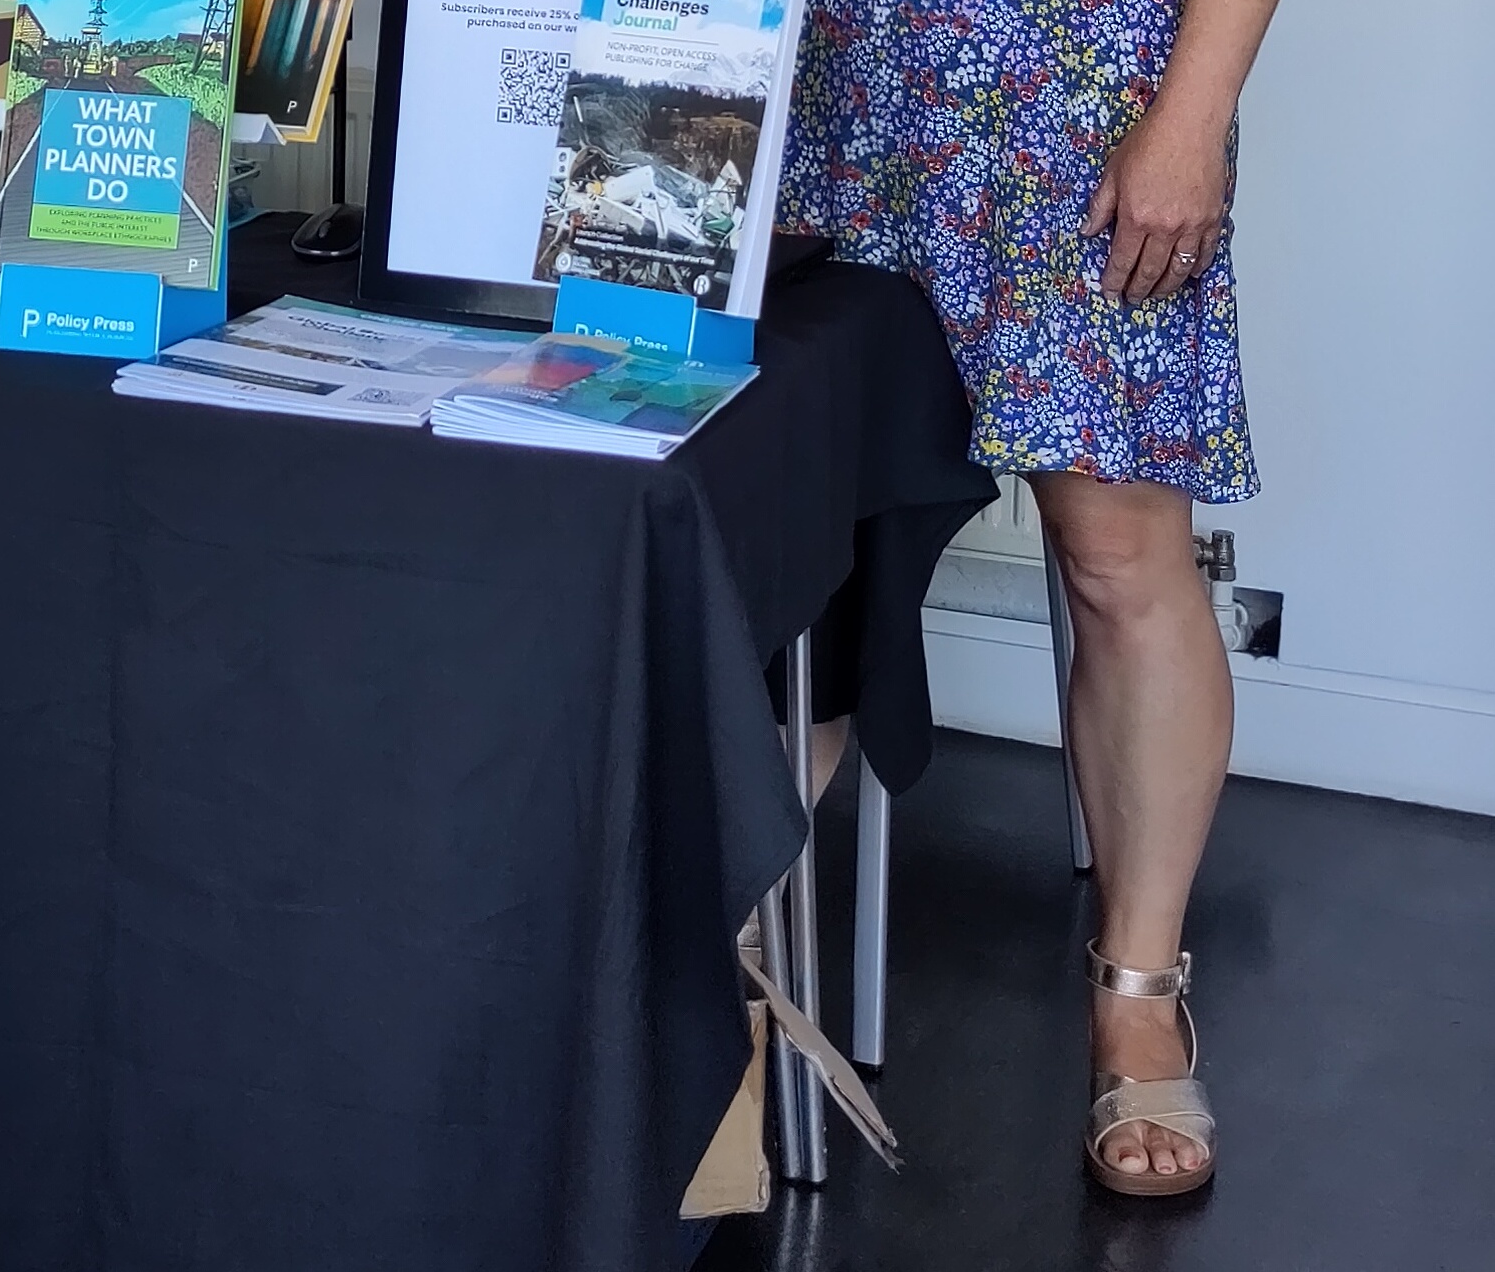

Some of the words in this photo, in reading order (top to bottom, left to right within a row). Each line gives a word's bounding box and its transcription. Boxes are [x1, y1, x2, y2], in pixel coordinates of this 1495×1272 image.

[440, 1, 505, 16] Subscribers
[506, 6, 548, 19] receive
[549, 8, 571, 20] 25%
[613, 11, 679, 32] Journal
[607, 40, 659, 57] NON-PROFIT,
[661, 45, 684, 58] OPEN
[686, 48, 717, 62] ACCESS
[78, 96, 157, 124] WHAT
[72, 123, 155, 150] TOWN
[44, 148, 177, 180] PLANNERS
[87, 177, 129, 203] DO
[46, 312, 90, 332] Policy
[94, 316, 135, 332] Press
